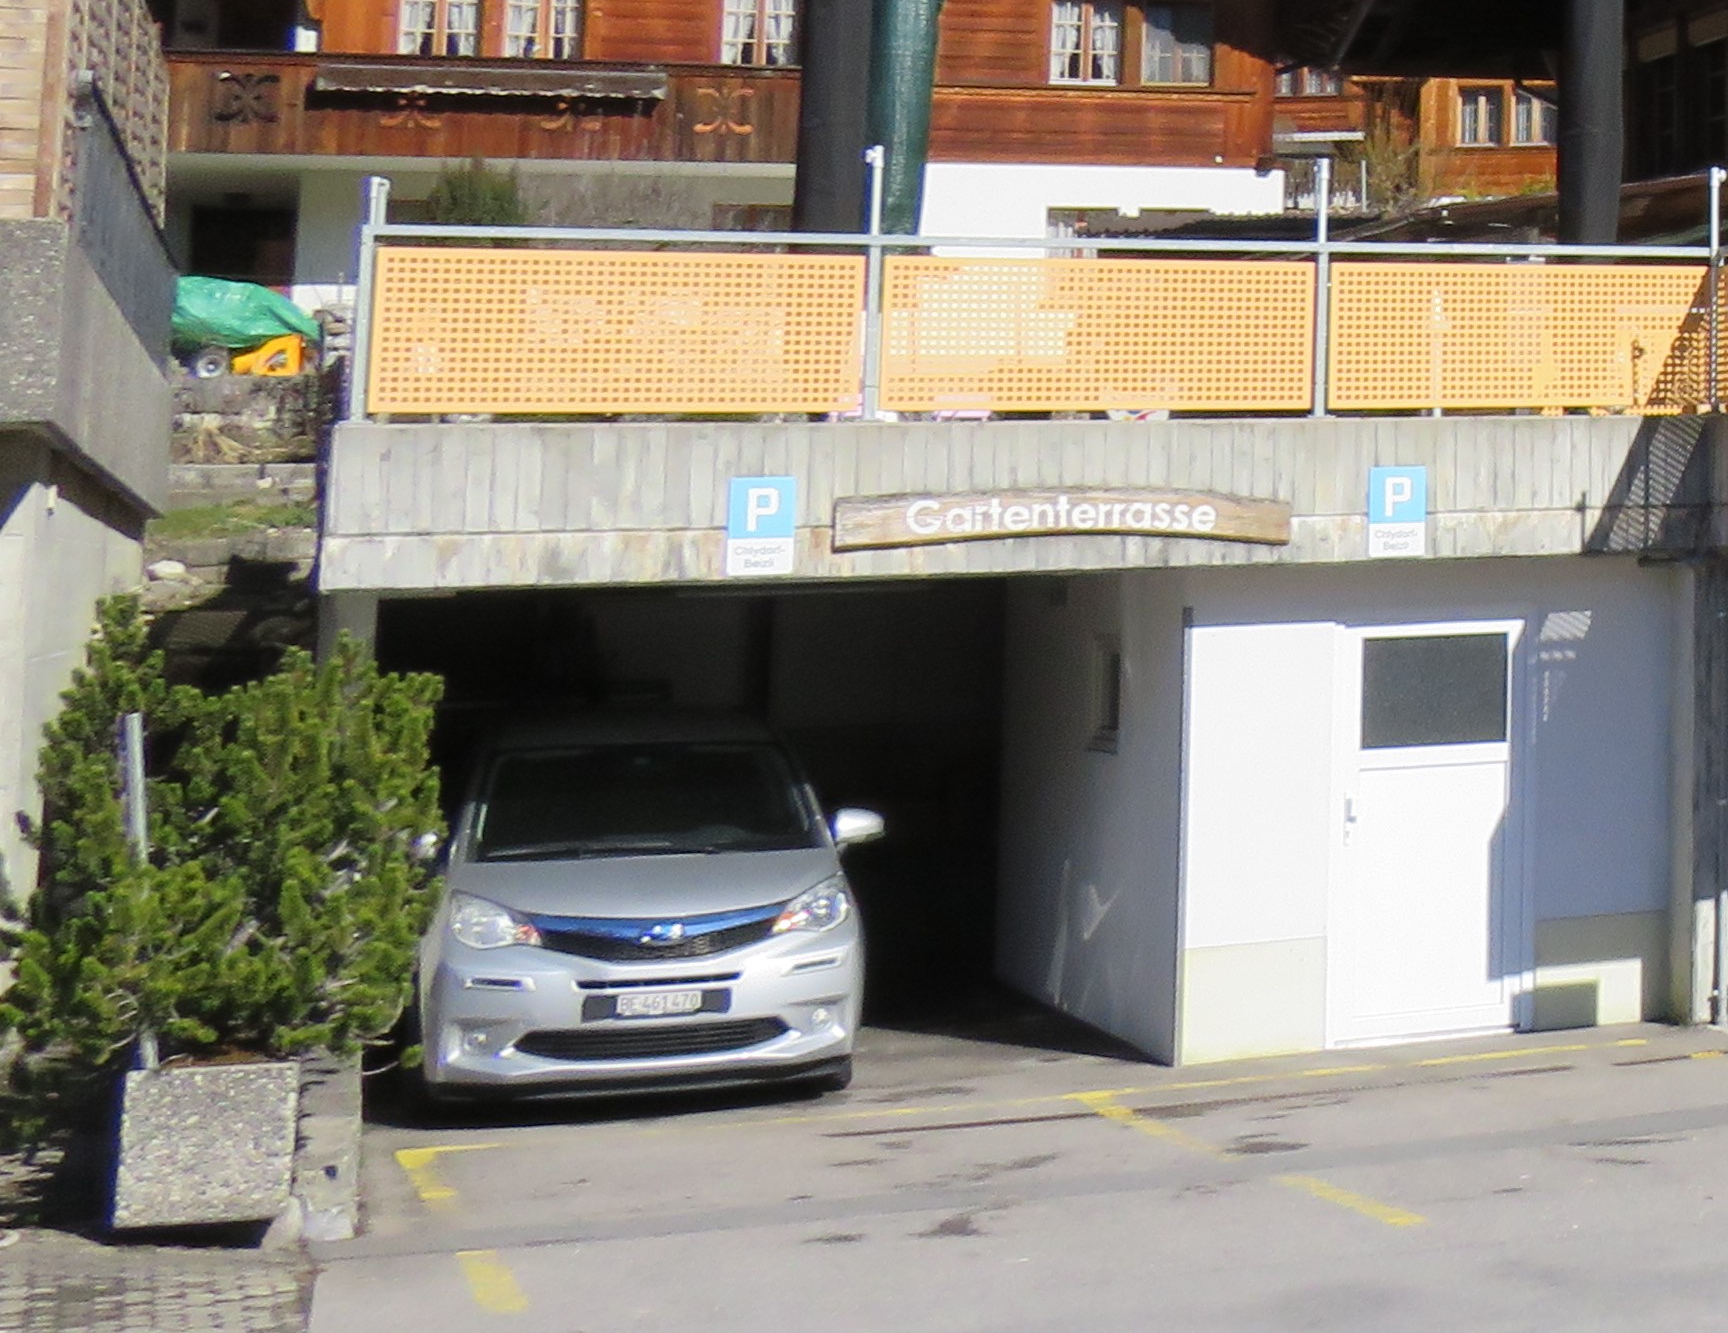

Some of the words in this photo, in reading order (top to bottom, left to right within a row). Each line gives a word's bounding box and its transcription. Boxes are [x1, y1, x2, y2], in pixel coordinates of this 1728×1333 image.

[746, 487, 779, 532] P
[905, 495, 1217, 534] Gartenterrasse
[1384, 476, 1412, 517] P
